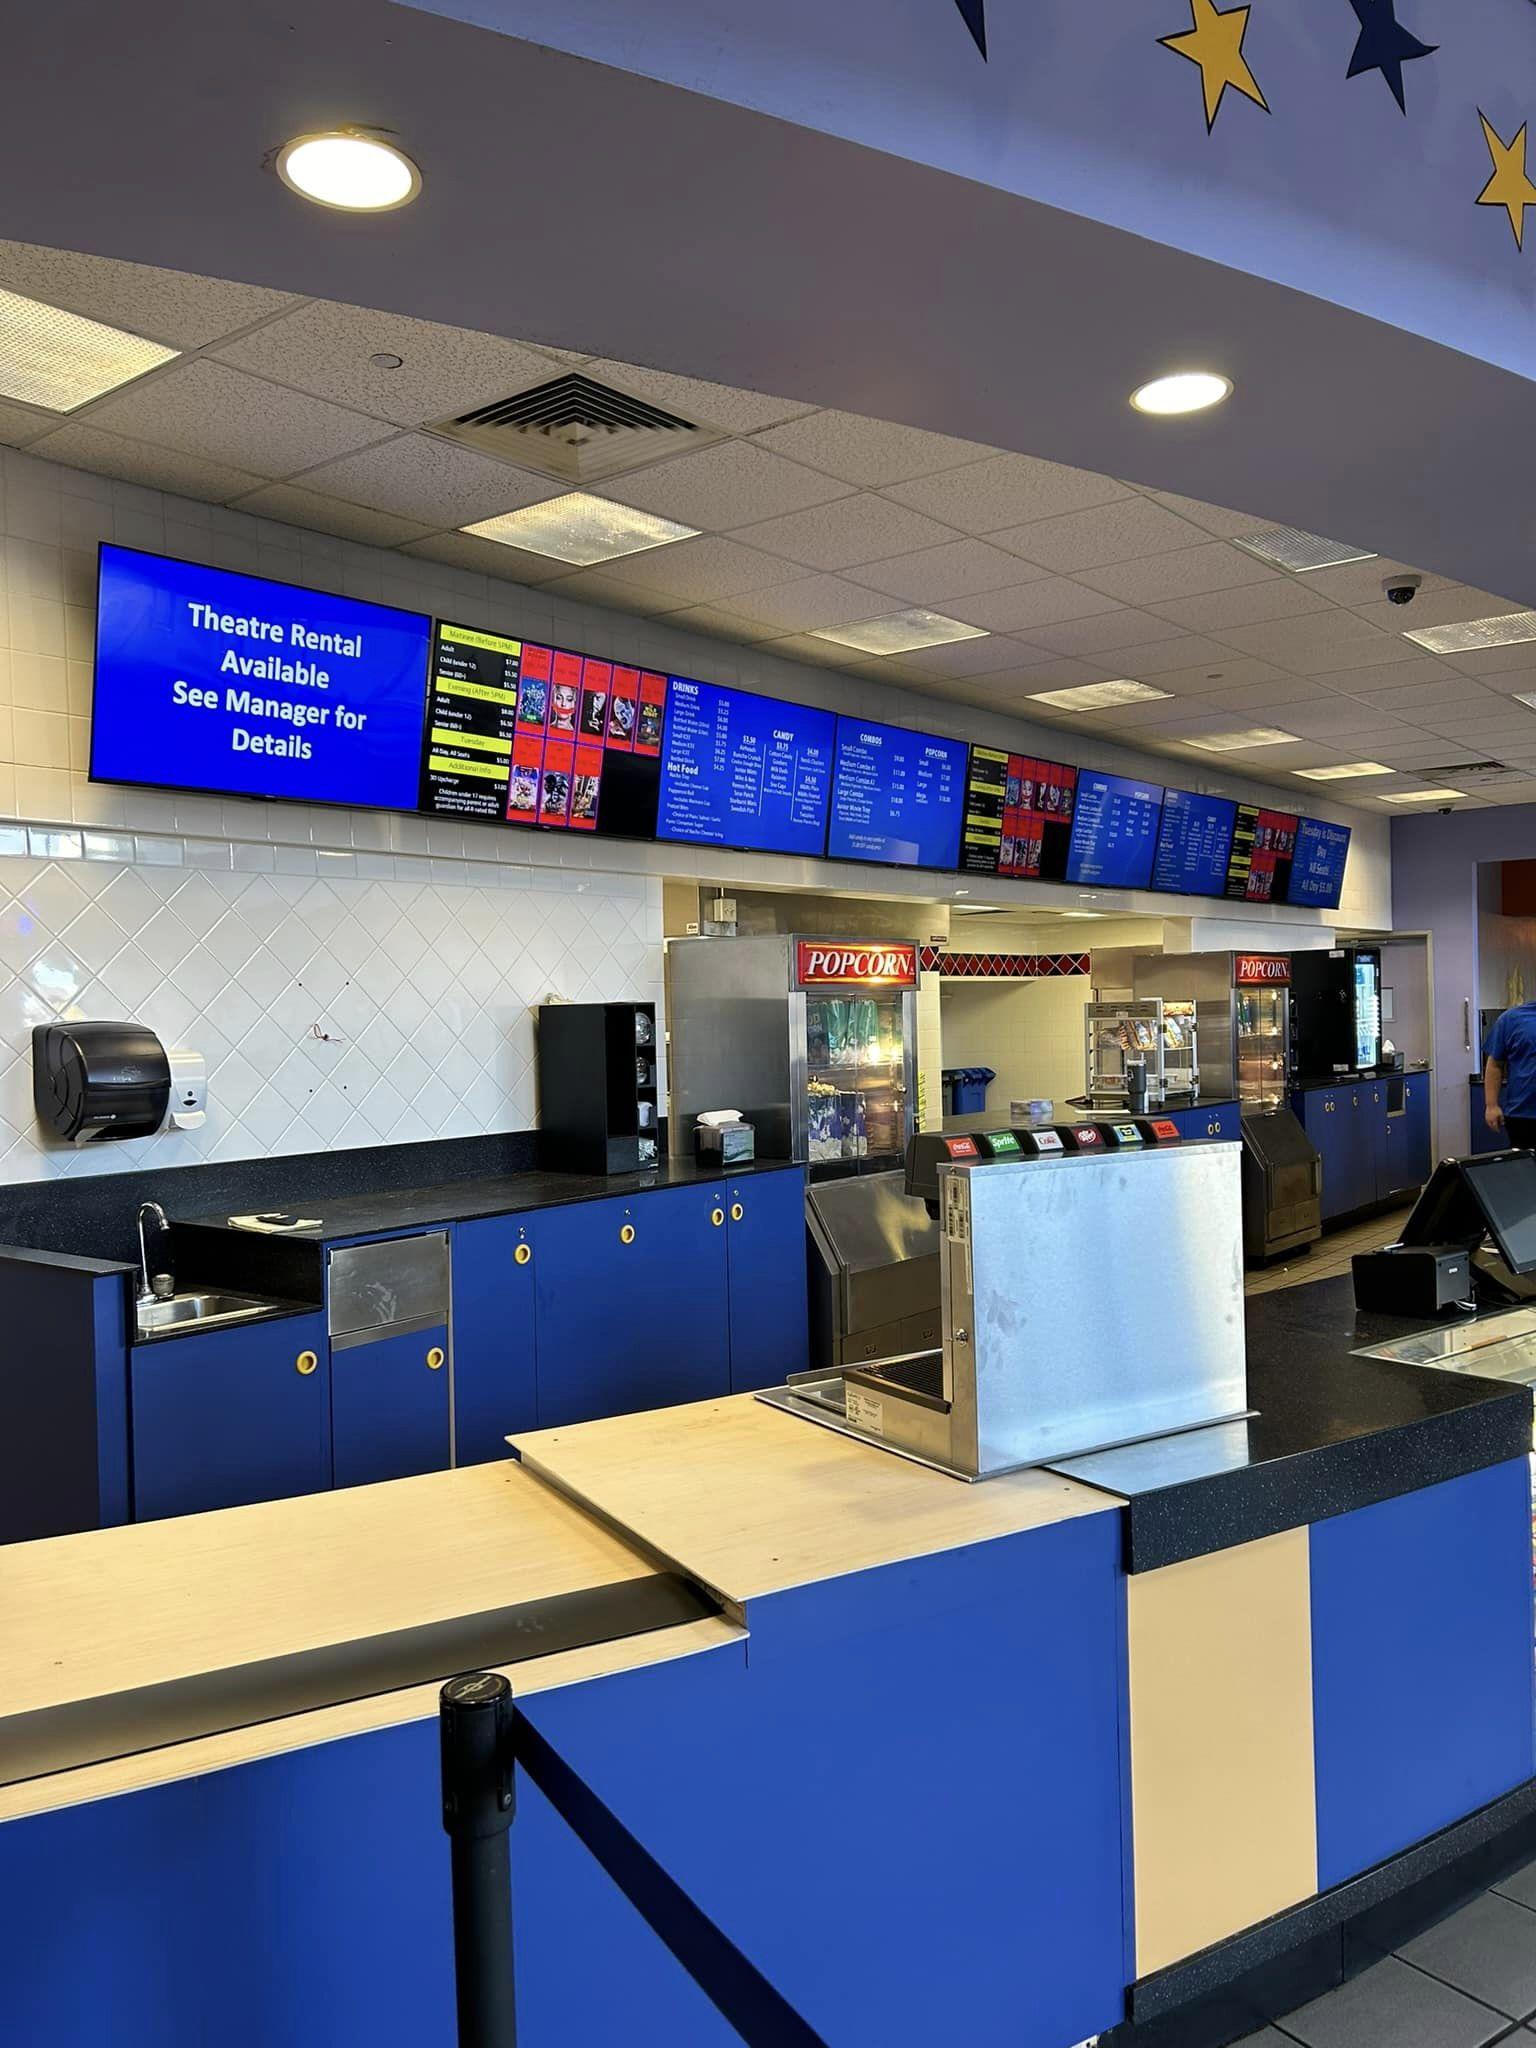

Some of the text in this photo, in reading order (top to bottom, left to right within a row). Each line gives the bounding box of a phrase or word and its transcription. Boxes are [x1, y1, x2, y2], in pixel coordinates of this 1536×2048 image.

[188, 603, 362, 658] Theatre Rental
[449, 629, 474, 641] Matinee
[440, 643, 454, 653] Adult
[439, 655, 452, 664] Child
[220, 650, 330, 689] Available
[447, 681, 471, 694] Evening
[472, 686, 490, 697] (After
[672, 681, 698, 695] DRINKS
[173, 680, 367, 730] See Manager for
[436, 695, 450, 704] Adult
[435, 707, 447, 715] Child
[461, 735, 484, 747] Tuesday
[773, 730, 794, 742] CANDY
[232, 728, 312, 760] Details
[925, 747, 947, 758] POPCORN
[448, 760, 491, 774] Additional Info
[667, 761, 698, 775] Hot Food
[437, 774, 459, 785] Upcharge
[917, 770, 932, 778] Medium
[916, 780, 927, 789] Large
[837, 787, 848, 796] Large
[1302, 823, 1321, 840] Tuesday
[1327, 829, 1347, 842] Discount
[1317, 845, 1327, 859] Day
[1309, 862, 1317, 873] All
[1309, 881, 1319, 895] Day
[808, 951, 912, 976] POPCORN
[1240, 960, 1288, 977] POPCORN
[992, 1136, 1016, 1148] Sprite
